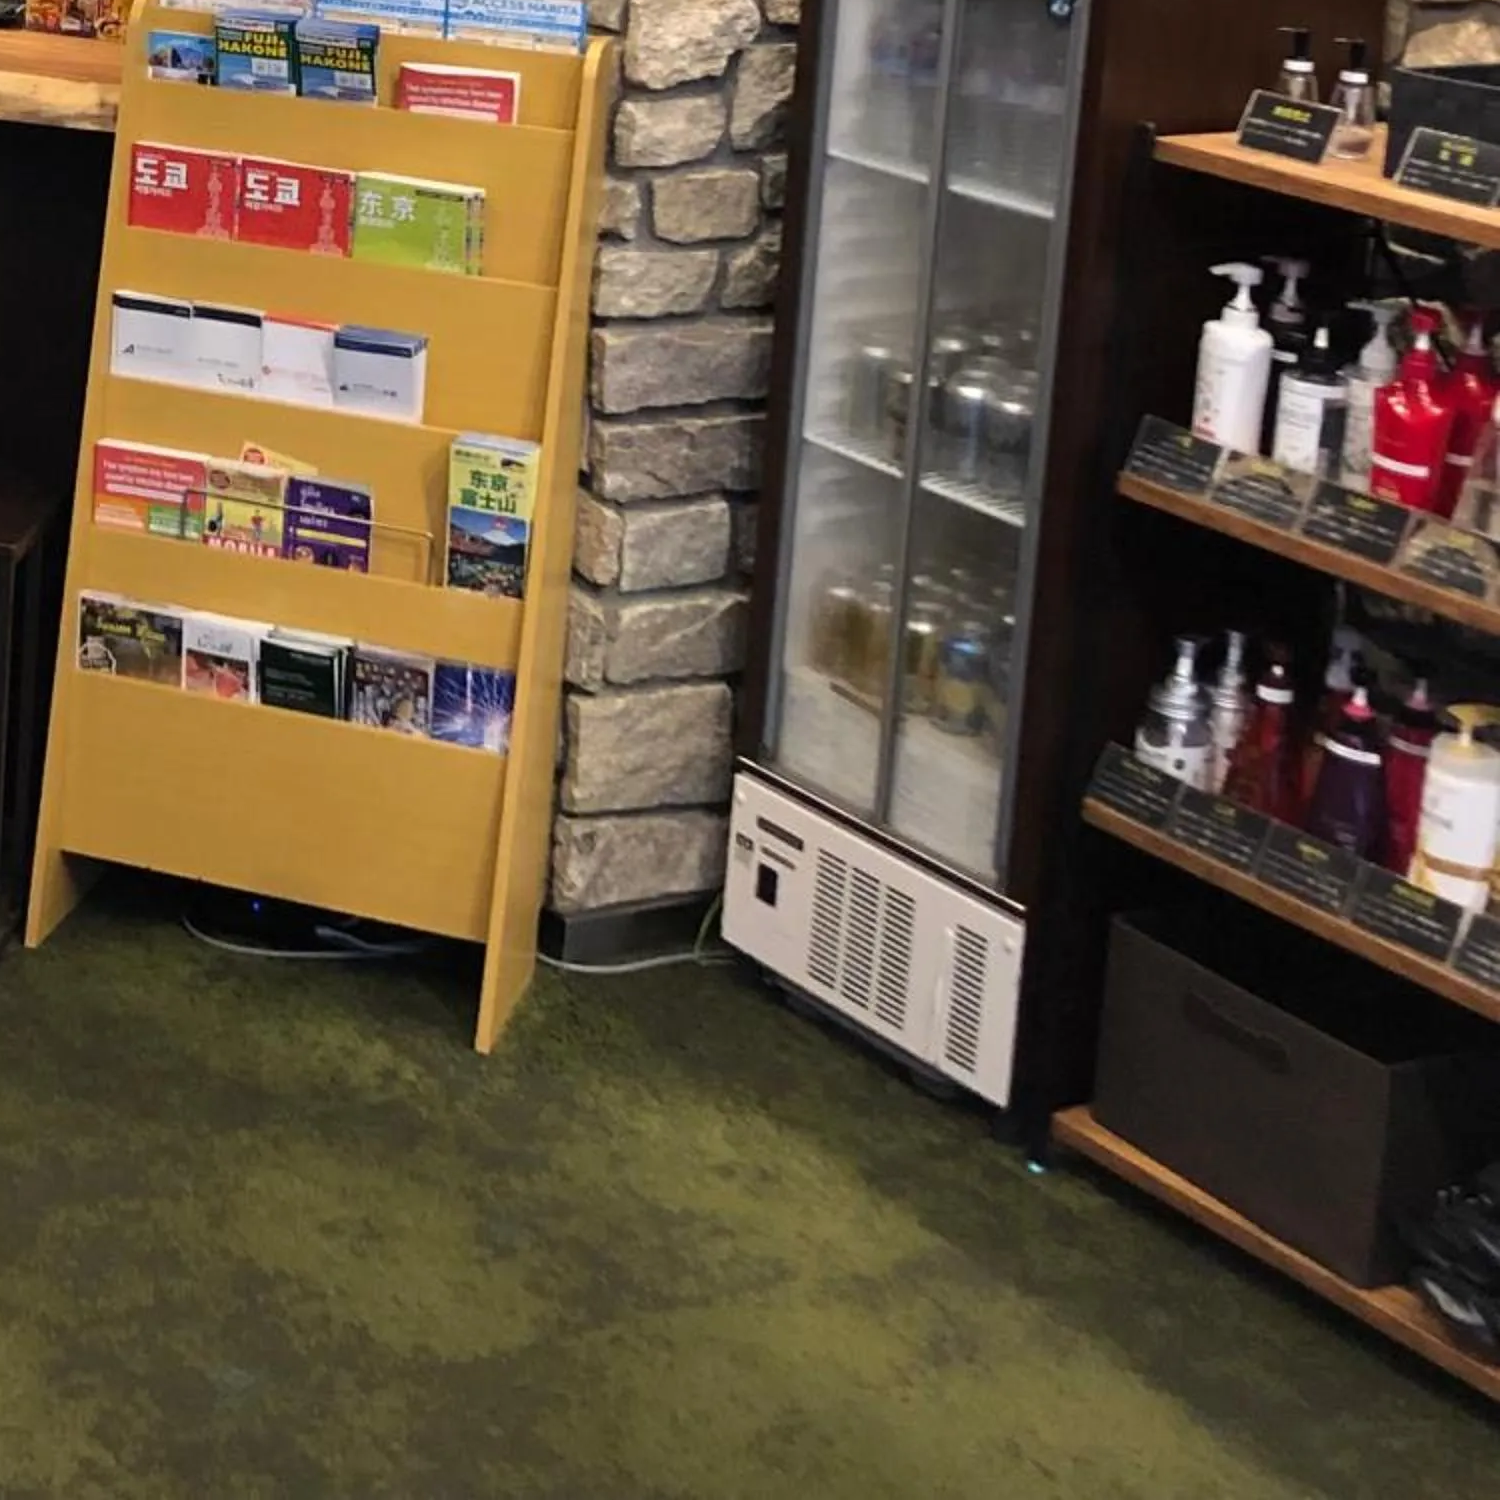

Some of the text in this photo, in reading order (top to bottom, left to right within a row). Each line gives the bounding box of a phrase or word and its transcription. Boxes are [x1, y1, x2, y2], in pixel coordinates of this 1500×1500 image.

[527, 2, 579, 16] NARITA
[218, 40, 287, 57] HAKONE
[300, 53, 371, 72] HAKONE
[135, 156, 188, 190] 도쿄
[245, 172, 300, 208] 도쿄
